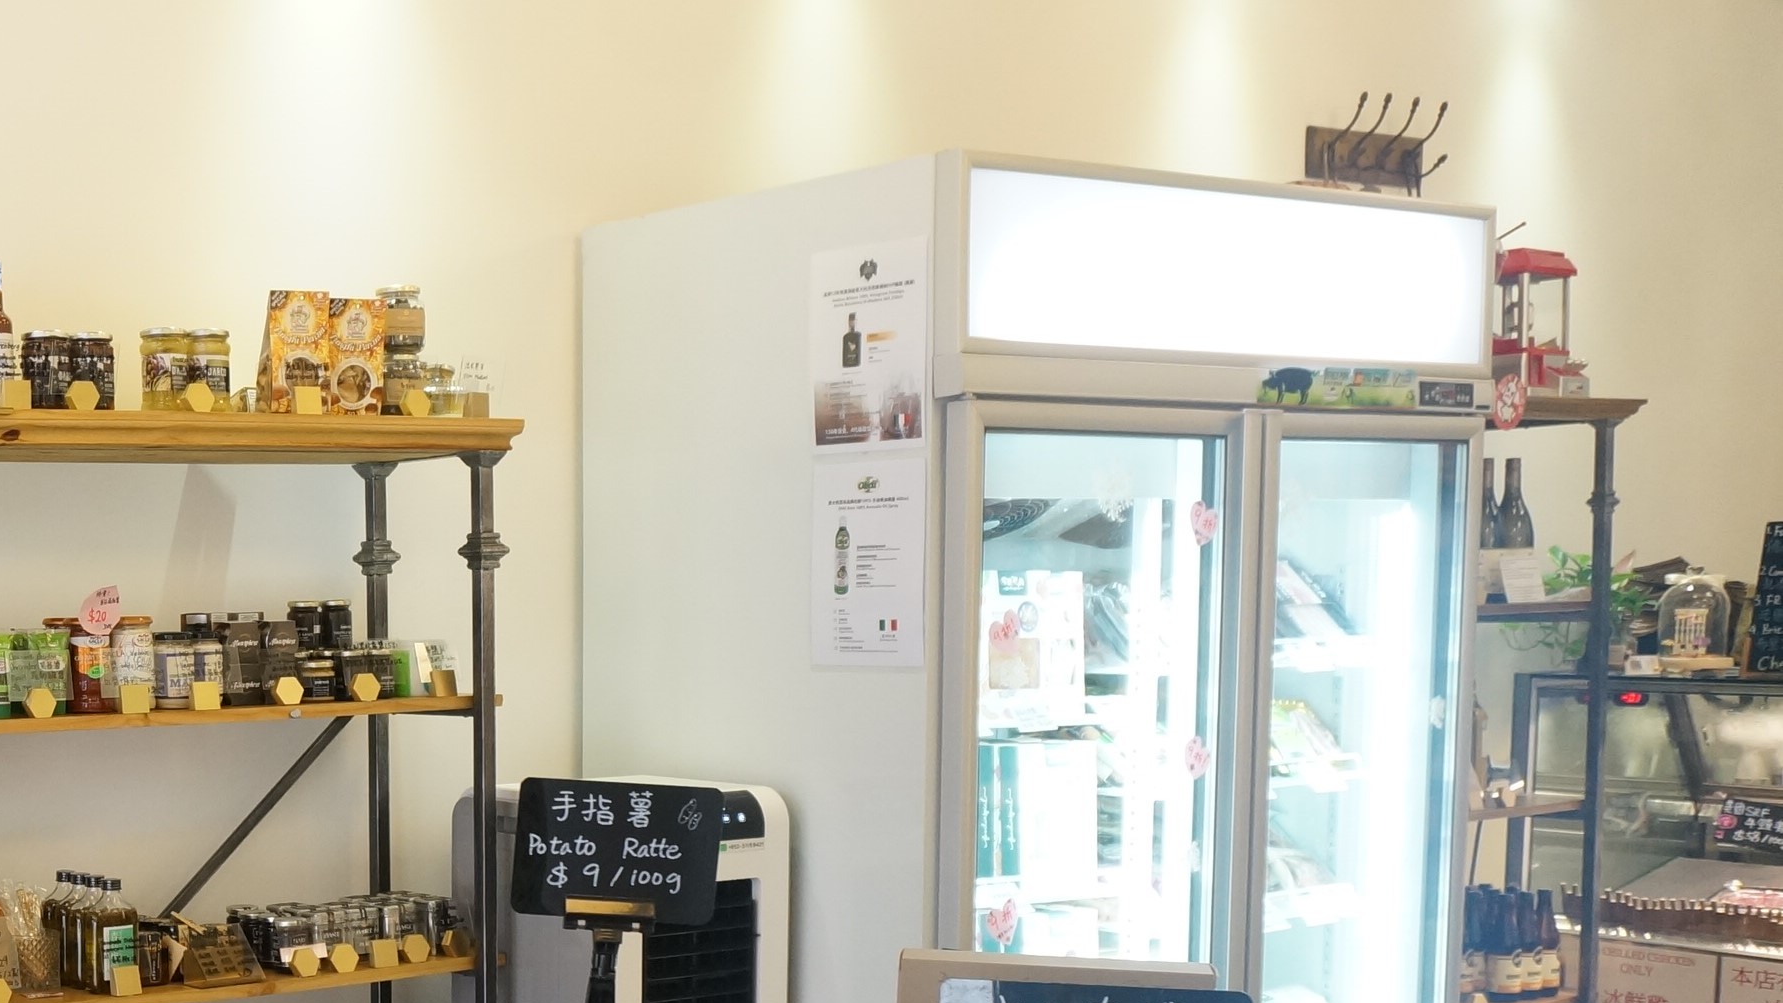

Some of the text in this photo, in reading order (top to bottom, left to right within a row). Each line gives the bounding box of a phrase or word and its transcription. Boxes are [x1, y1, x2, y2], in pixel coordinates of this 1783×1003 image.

[88, 608, 107, 623] $20
[551, 790, 654, 828] 手指薯
[528, 833, 683, 860] Potato Ratte
[1620, 964, 1654, 977] ONLY
